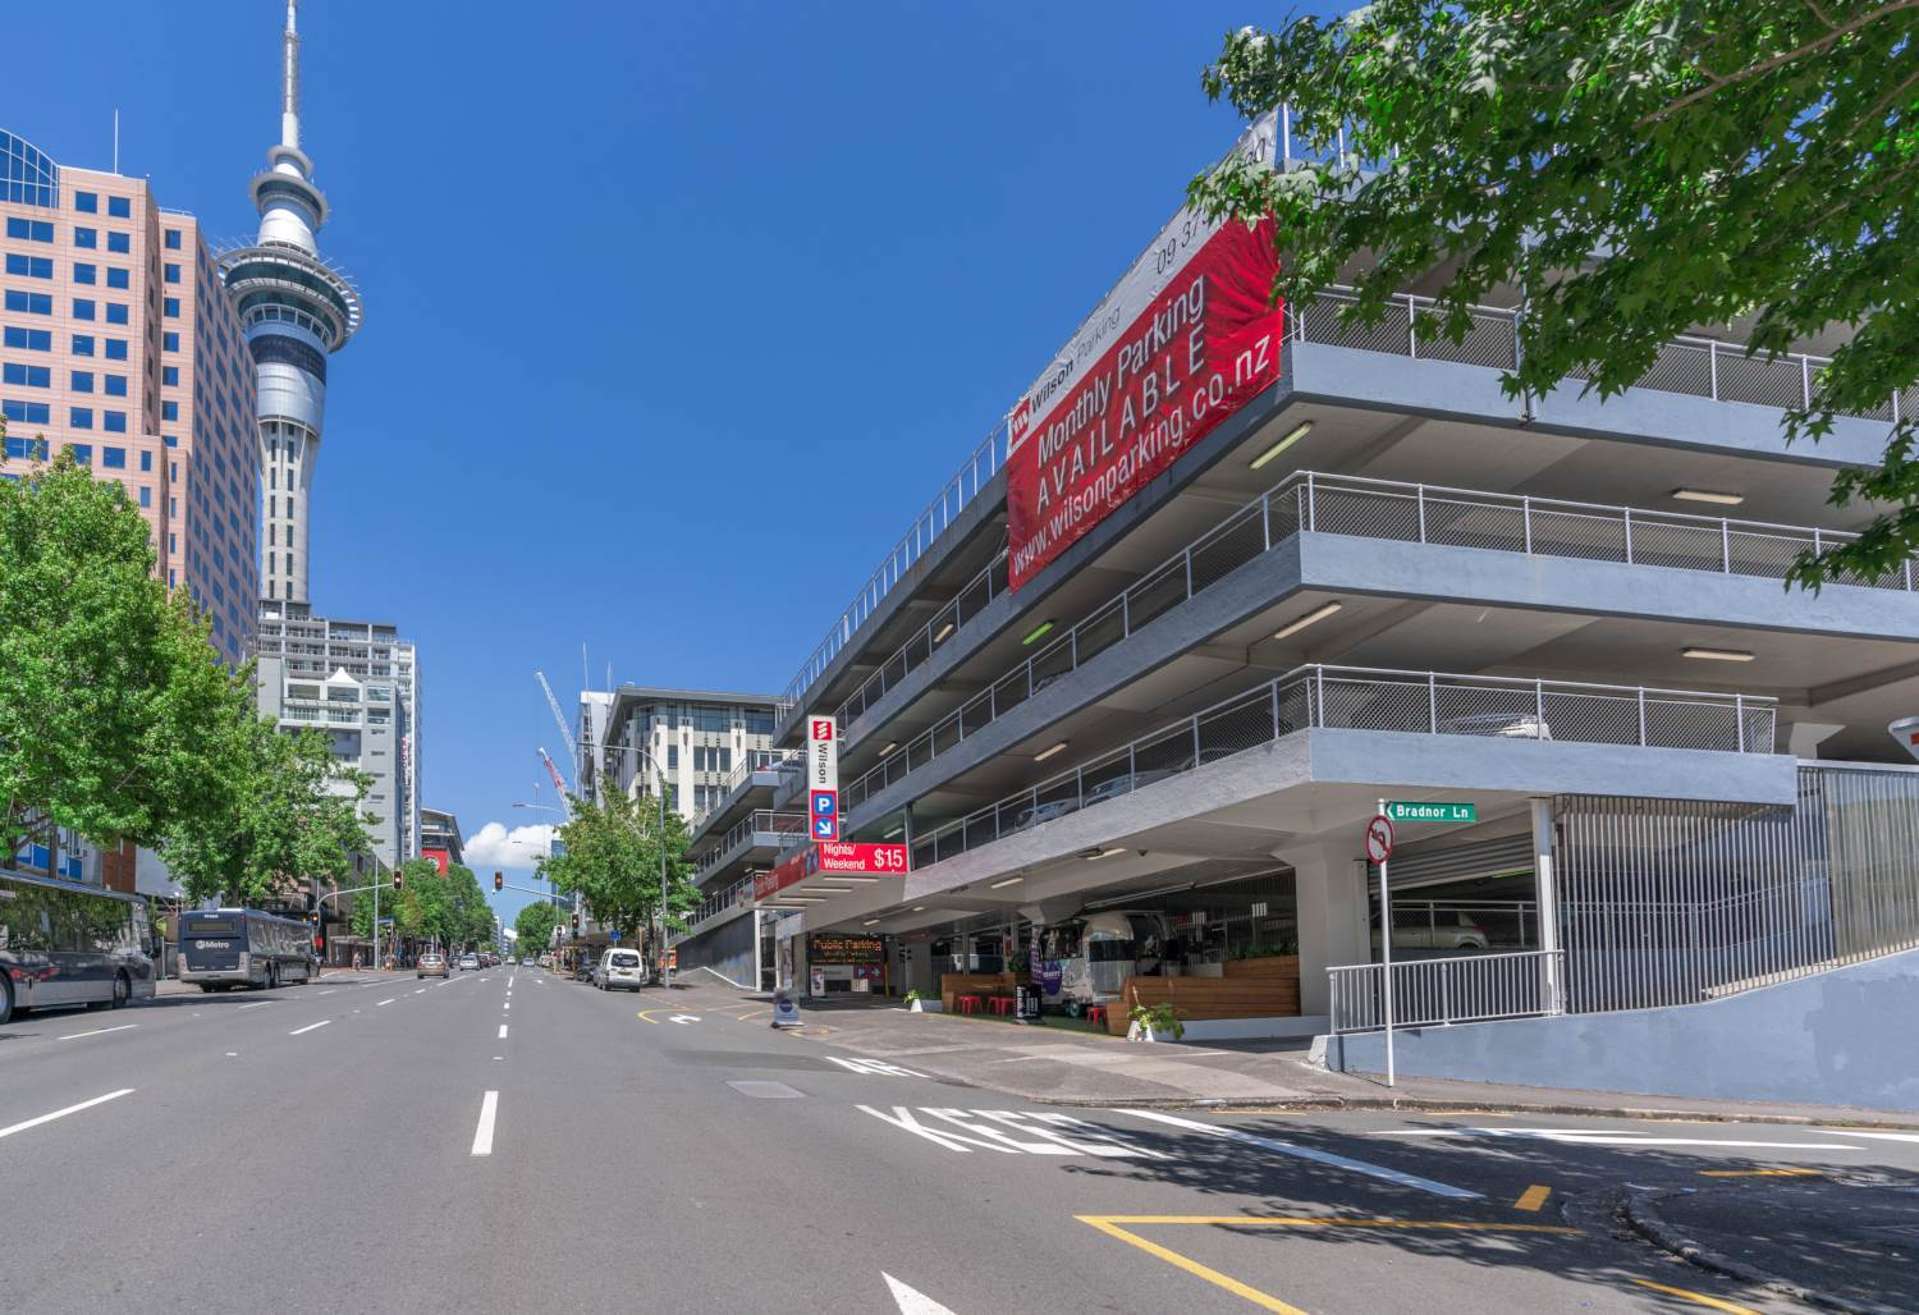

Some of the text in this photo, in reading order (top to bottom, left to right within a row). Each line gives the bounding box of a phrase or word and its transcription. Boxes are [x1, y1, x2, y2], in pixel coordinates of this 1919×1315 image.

[1032, 359, 1074, 413] Wilson
[1077, 307, 1120, 364] Parking
[1157, 238, 1176, 274] 09
[1038, 274, 1204, 469] Monthly Parking
[1037, 323, 1204, 515] AVAILABLE
[1014, 335, 1271, 576] www.wilsonparking.co.nz
[818, 743, 828, 784] Wilson
[818, 798, 830, 812] P
[1396, 805, 1469, 818] Bradnor Ln
[823, 858, 866, 870] Weekend
[874, 848, 903, 868] $15
[205, 941, 230, 949] Metro
[813, 939, 881, 952] Public Parking
[853, 1104, 1177, 1160] KEEP
